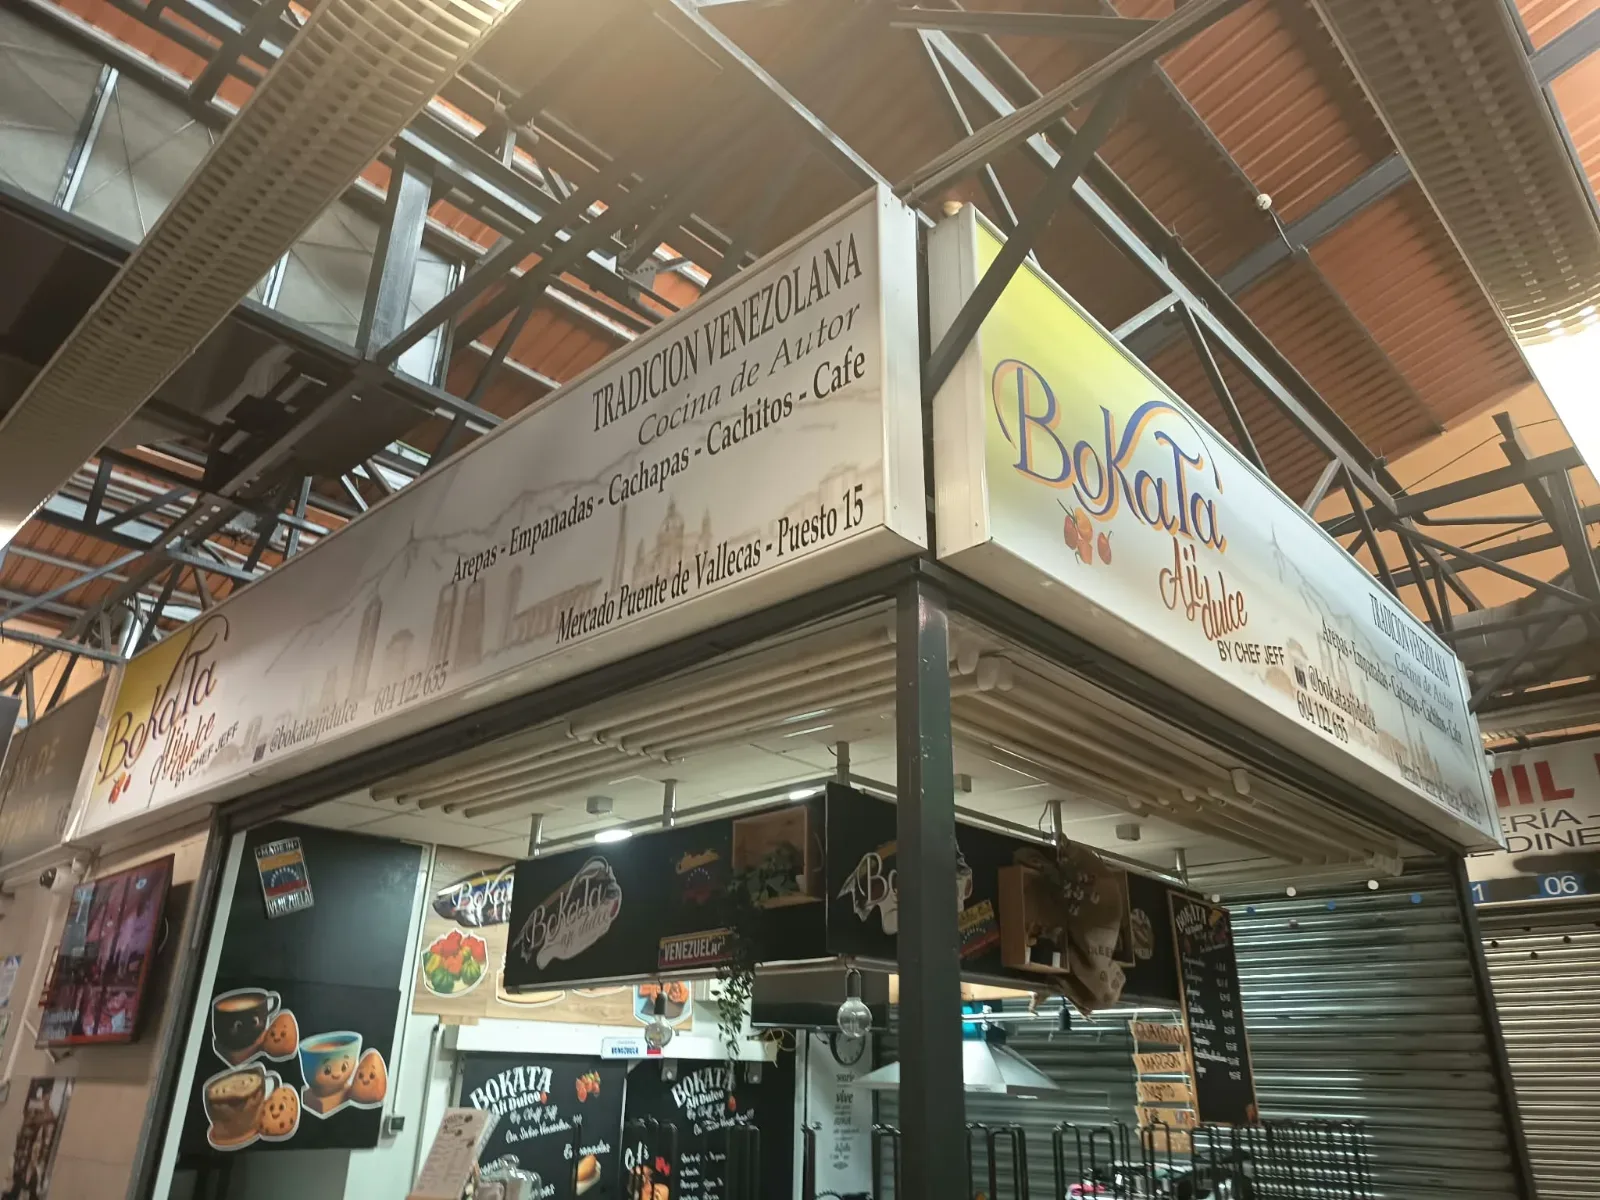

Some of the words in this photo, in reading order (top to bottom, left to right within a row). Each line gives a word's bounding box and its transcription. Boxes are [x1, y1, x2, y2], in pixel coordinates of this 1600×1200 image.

[592, 330, 699, 431] TRADICION
[703, 233, 862, 366] VENEZOLANA
[638, 384, 721, 446] Cocina
[730, 357, 760, 398] de
[768, 302, 861, 375] Autor
[451, 543, 498, 585] Arepas
[509, 496, 594, 557] Empanadas
[608, 446, 690, 507] Cachapas
[707, 391, 793, 456] Cachitos
[813, 346, 866, 399] Cafe
[556, 598, 614, 645] Mercado
[617, 577, 668, 621] Puente
[671, 566, 690, 595] de
[695, 537, 762, 590] Vallecas
[777, 510, 838, 557] Puesto
[843, 485, 865, 528] 15
[1217, 640, 1233, 662] BY
[1234, 642, 1262, 665] CHEF
[1264, 645, 1286, 667] JEFF
[1321, 616, 1350, 660] Arepas
[399, 672, 422, 706] 122
[423, 660, 450, 697] 655
[188, 743, 215, 776] CHEF
[215, 720, 240, 753] JEFF
[1331, 712, 1349, 744] 655
[1544, 875, 1579, 896] 06
[469, 1065, 553, 1112] BOKATA
[671, 1062, 737, 1109] BOKATA
